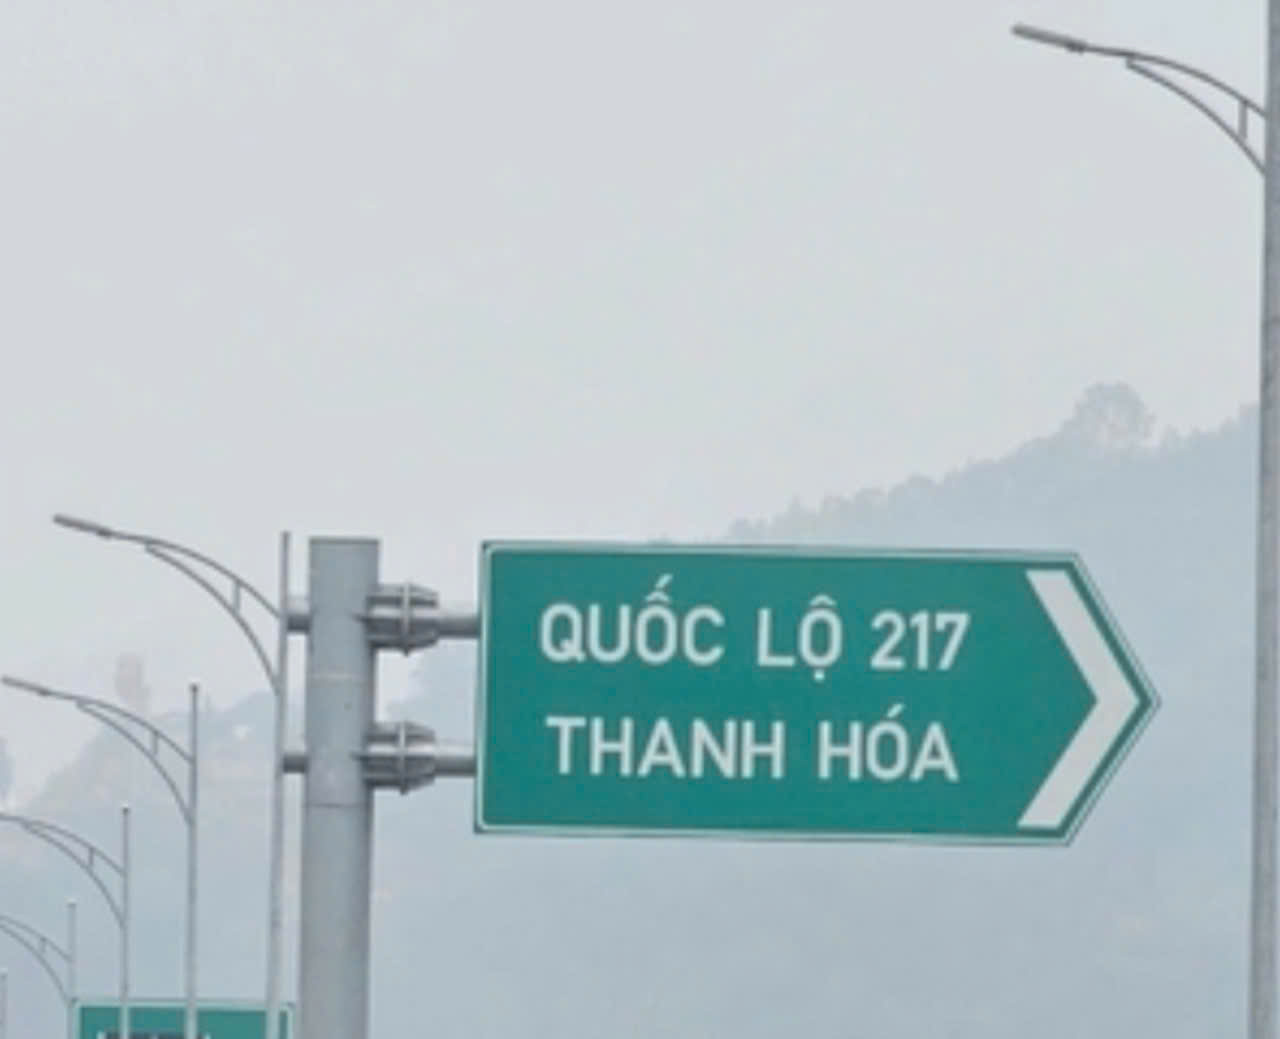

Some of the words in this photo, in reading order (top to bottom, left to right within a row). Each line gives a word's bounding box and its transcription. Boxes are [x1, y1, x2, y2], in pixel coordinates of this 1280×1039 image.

[540, 574, 724, 665] QUỐC
[756, 595, 843, 681] LỘ
[870, 611, 971, 671] 217
[545, 715, 785, 779] THANH
[819, 703, 959, 782] HÓA
